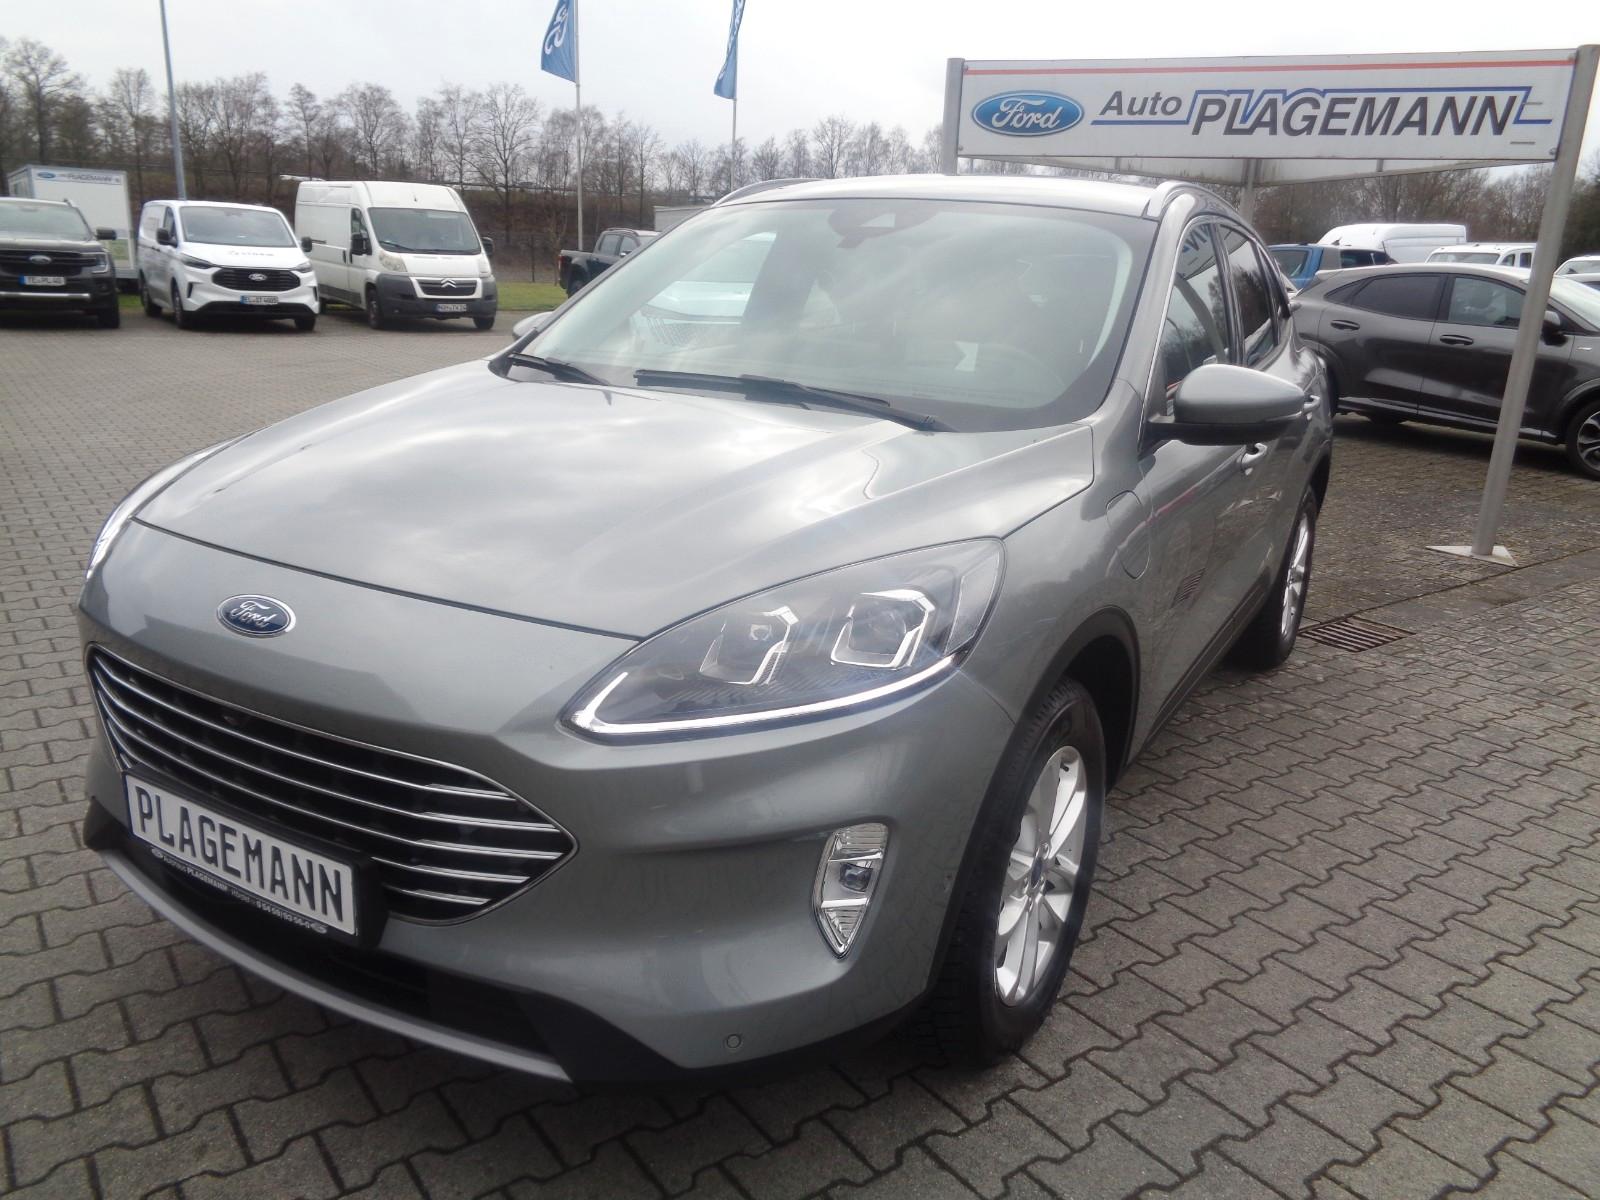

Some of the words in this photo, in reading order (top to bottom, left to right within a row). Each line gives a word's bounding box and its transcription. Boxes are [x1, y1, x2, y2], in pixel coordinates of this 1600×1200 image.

[991, 97, 1063, 129] Ford
[1099, 90, 1183, 117] Auto
[1191, 95, 1516, 137] PLAGEMANN
[231, 600, 277, 627] Ford
[135, 786, 343, 922] PLAGEMANN
